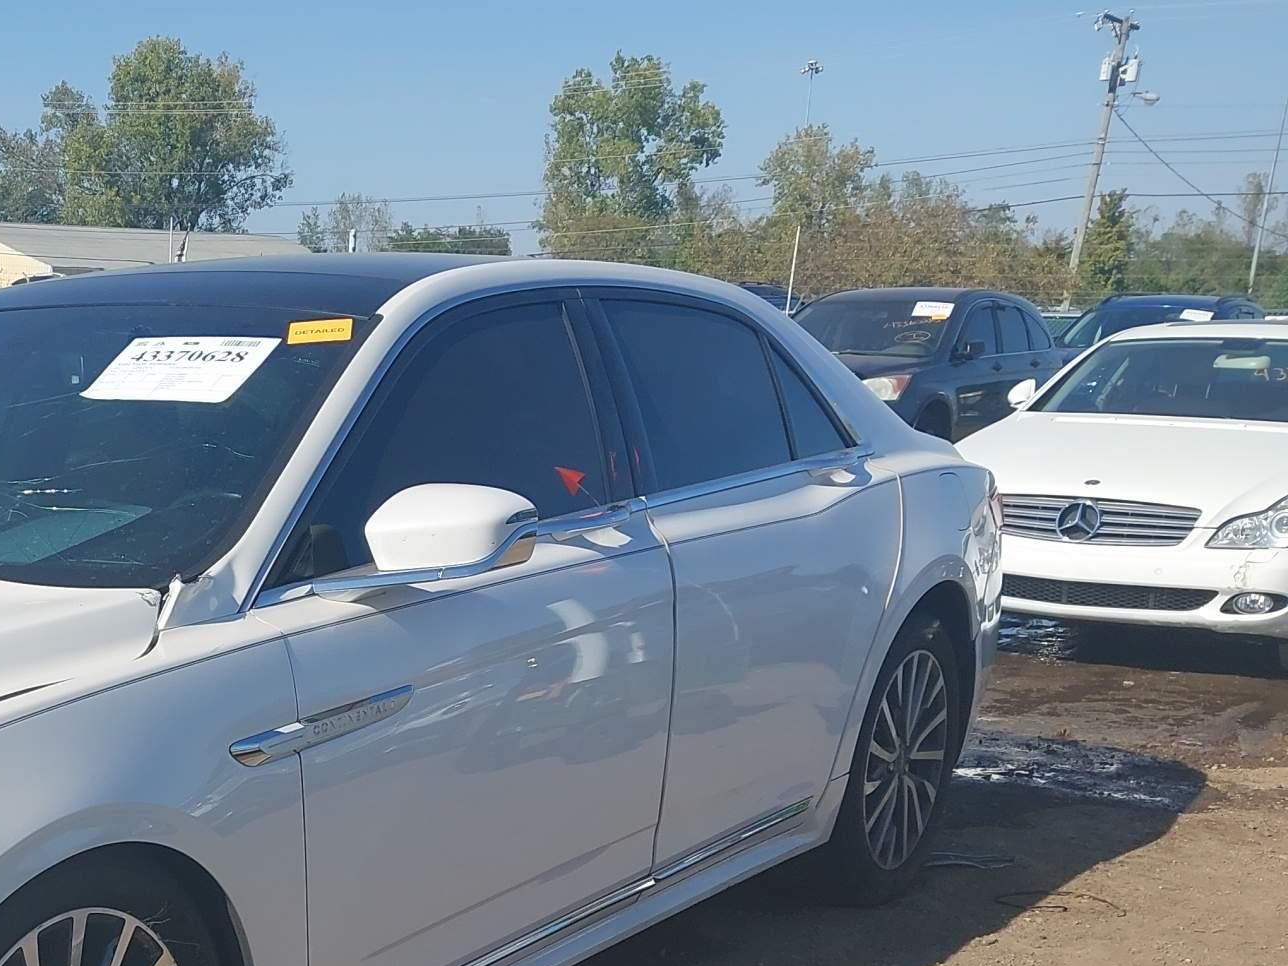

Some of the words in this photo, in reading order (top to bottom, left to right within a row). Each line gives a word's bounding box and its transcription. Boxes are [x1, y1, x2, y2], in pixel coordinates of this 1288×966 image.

[294, 327, 345, 336] DETAILED
[130, 350, 249, 363] 43370628
[1253, 367, 1288, 381] 43
